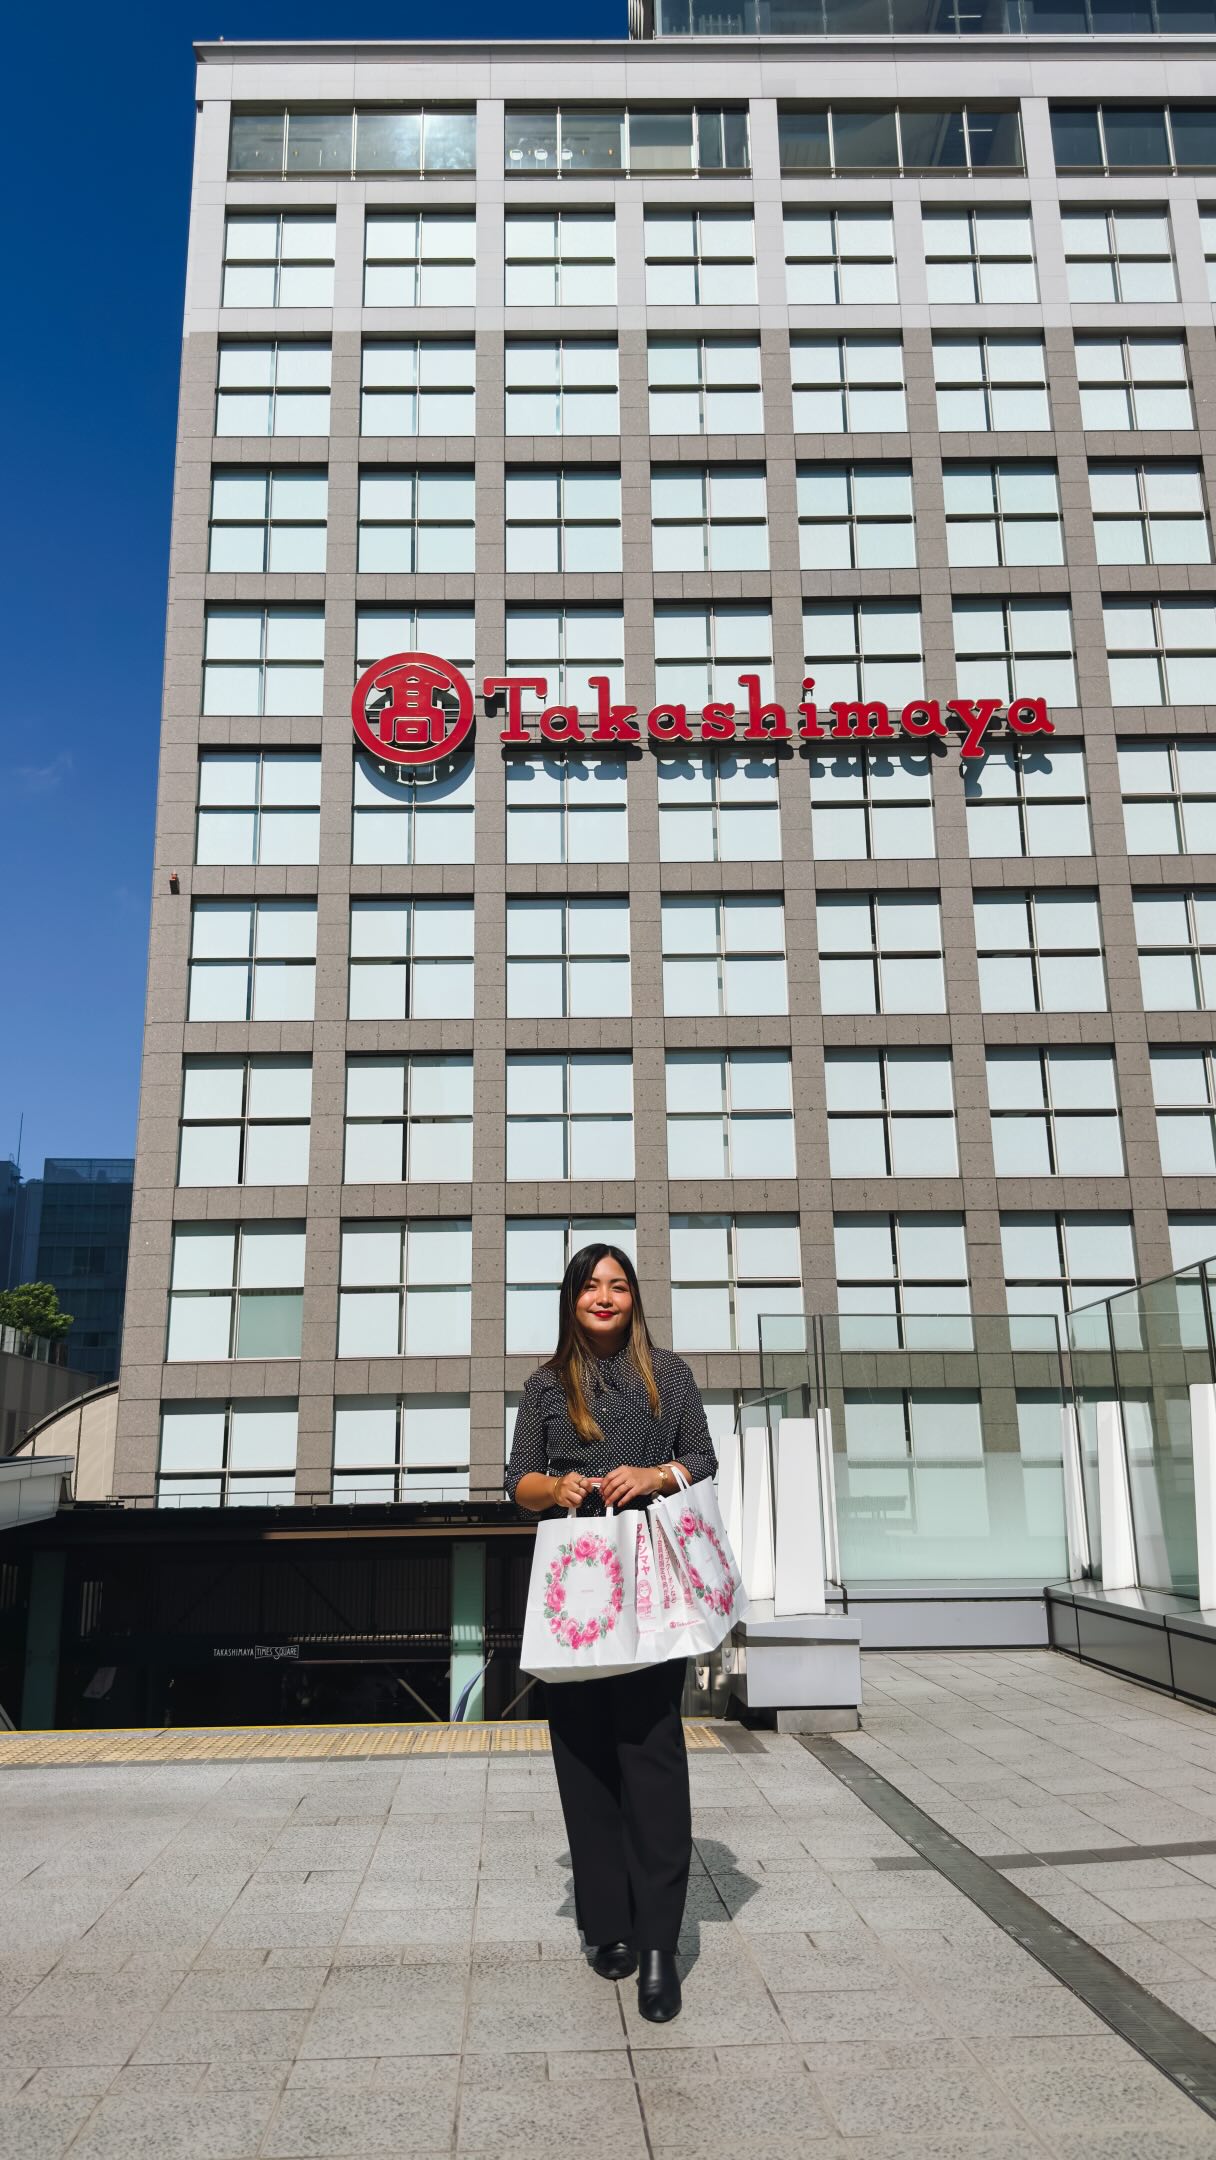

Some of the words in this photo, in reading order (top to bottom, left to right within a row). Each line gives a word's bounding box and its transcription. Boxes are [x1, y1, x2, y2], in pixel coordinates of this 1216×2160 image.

[483, 674, 1055, 757] Takashimaya
[213, 1648, 254, 1657] TAKASHIMAYA
[256, 1647, 273, 1656] TIMES
[273, 1647, 297, 1660] SQUARE
